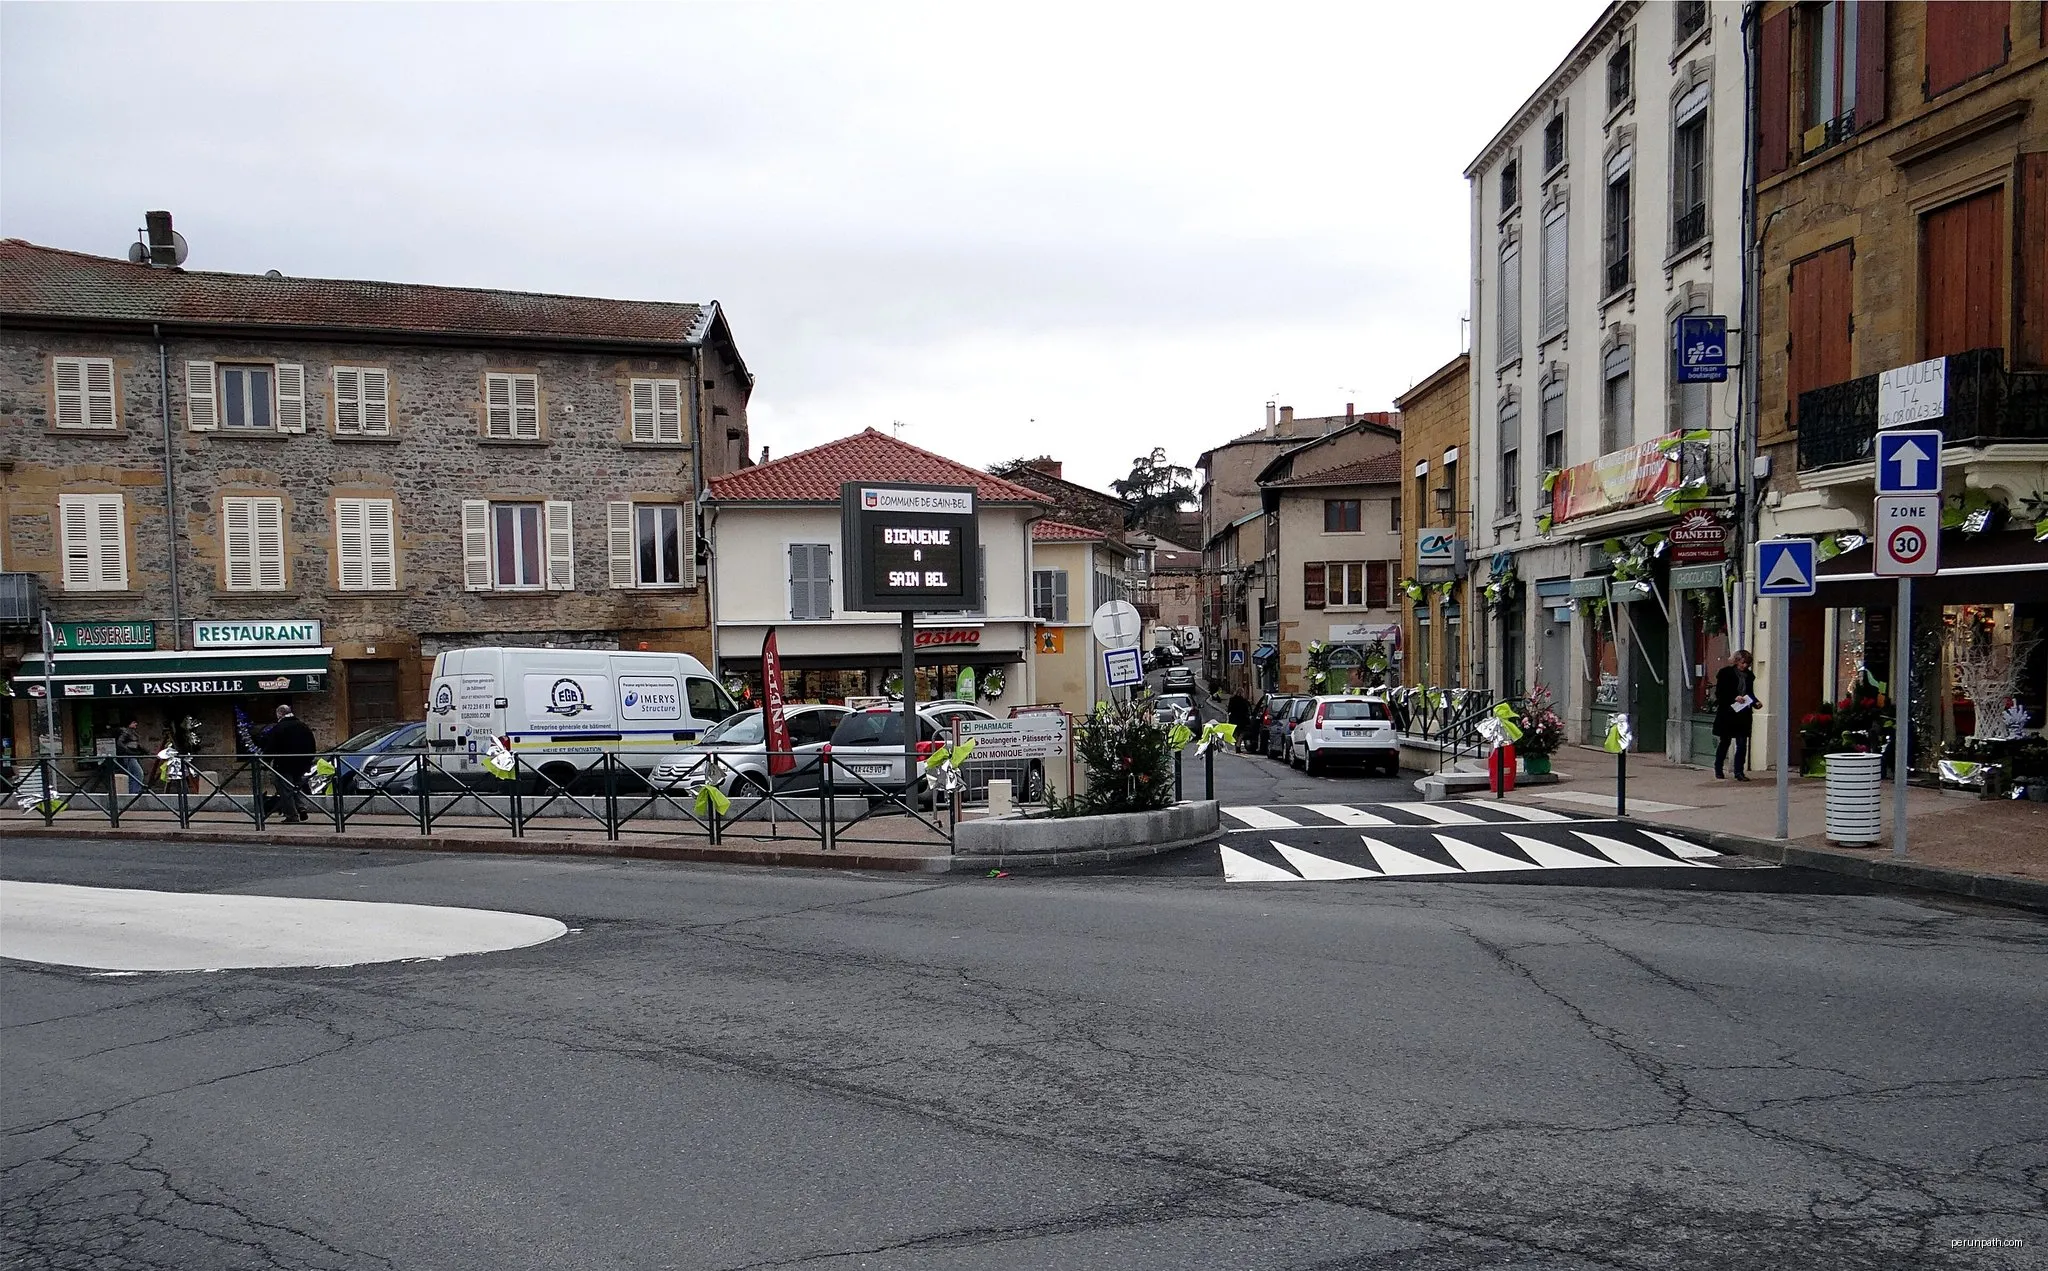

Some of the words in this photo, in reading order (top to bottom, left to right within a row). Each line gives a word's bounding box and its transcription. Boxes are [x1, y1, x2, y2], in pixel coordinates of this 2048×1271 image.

[1881, 372, 1891, 391] A
[1896, 359, 1942, 388] LOUER
[881, 495, 919, 507] COMMUNE
[921, 497, 931, 507] DE
[932, 498, 967, 509] SAIN-BEL
[1891, 507, 1926, 517] ZONE
[884, 529, 950, 545] BIENVENUE
[1675, 530, 1721, 539] BANETTE
[1896, 537, 1918, 552] 30
[914, 550, 921, 561] A
[889, 571, 919, 586] SAIN
[925, 571, 947, 586] BEL
[76, 625, 151, 645] PASSERELLE
[200, 625, 313, 641] RESTAURANT
[914, 630, 980, 647] asino
[111, 683, 133, 695] LA
[143, 680, 243, 694] PASSERELLE
[559, 689, 578, 701] EGB
[640, 694, 675, 703] IMERYS
[974, 722, 1012, 730] PHARMACIE
[981, 736, 1017, 745] Boulangerie
[990, 749, 1022, 758] MONIQUE
